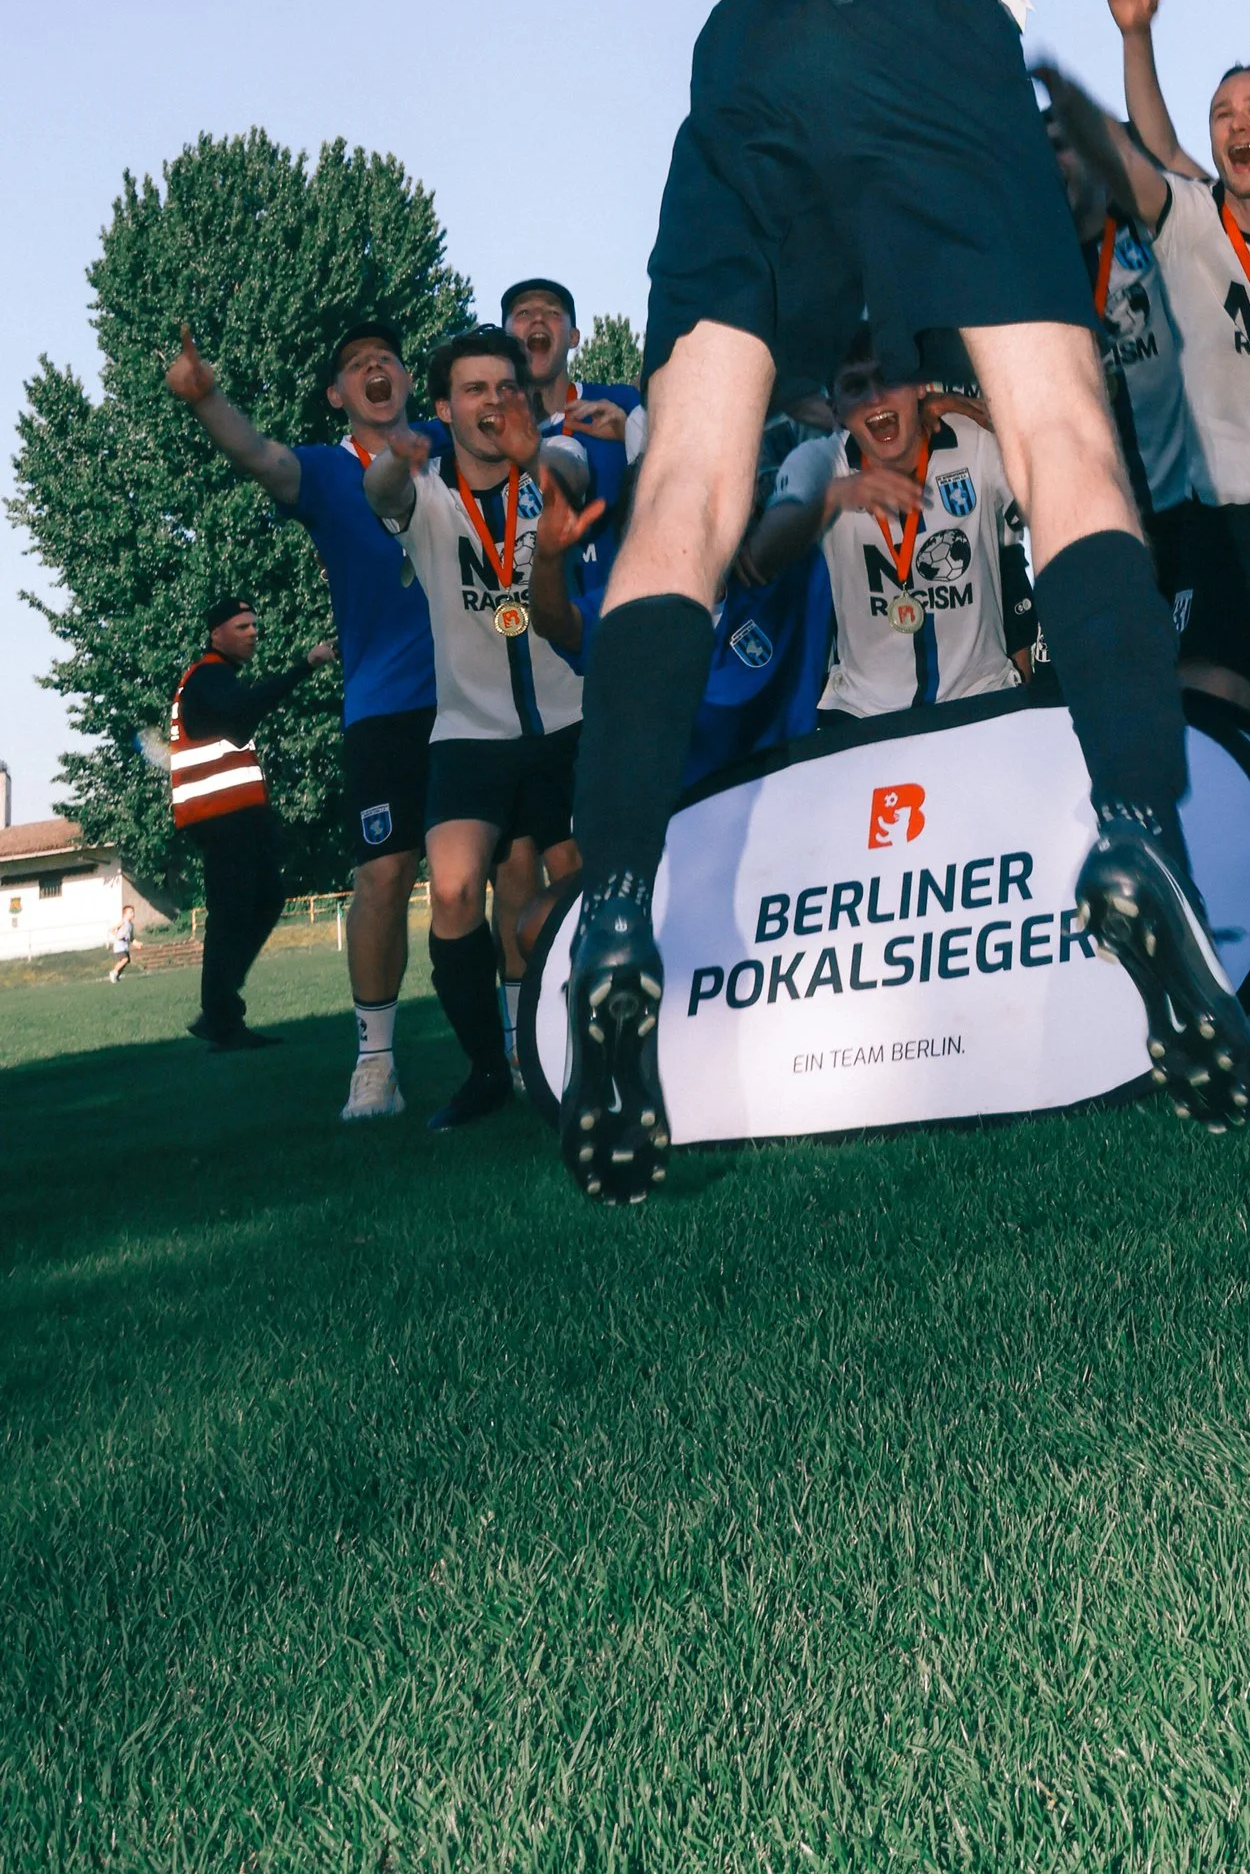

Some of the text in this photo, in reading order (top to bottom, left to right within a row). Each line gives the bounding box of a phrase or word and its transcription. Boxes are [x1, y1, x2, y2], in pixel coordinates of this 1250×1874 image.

[870, 582, 974, 617] RCISM
[754, 851, 1034, 944] BERLINER
[687, 908, 1096, 1017] POKALSIEGER
[793, 1035, 966, 1074] EIN TEAM BERLIN.
